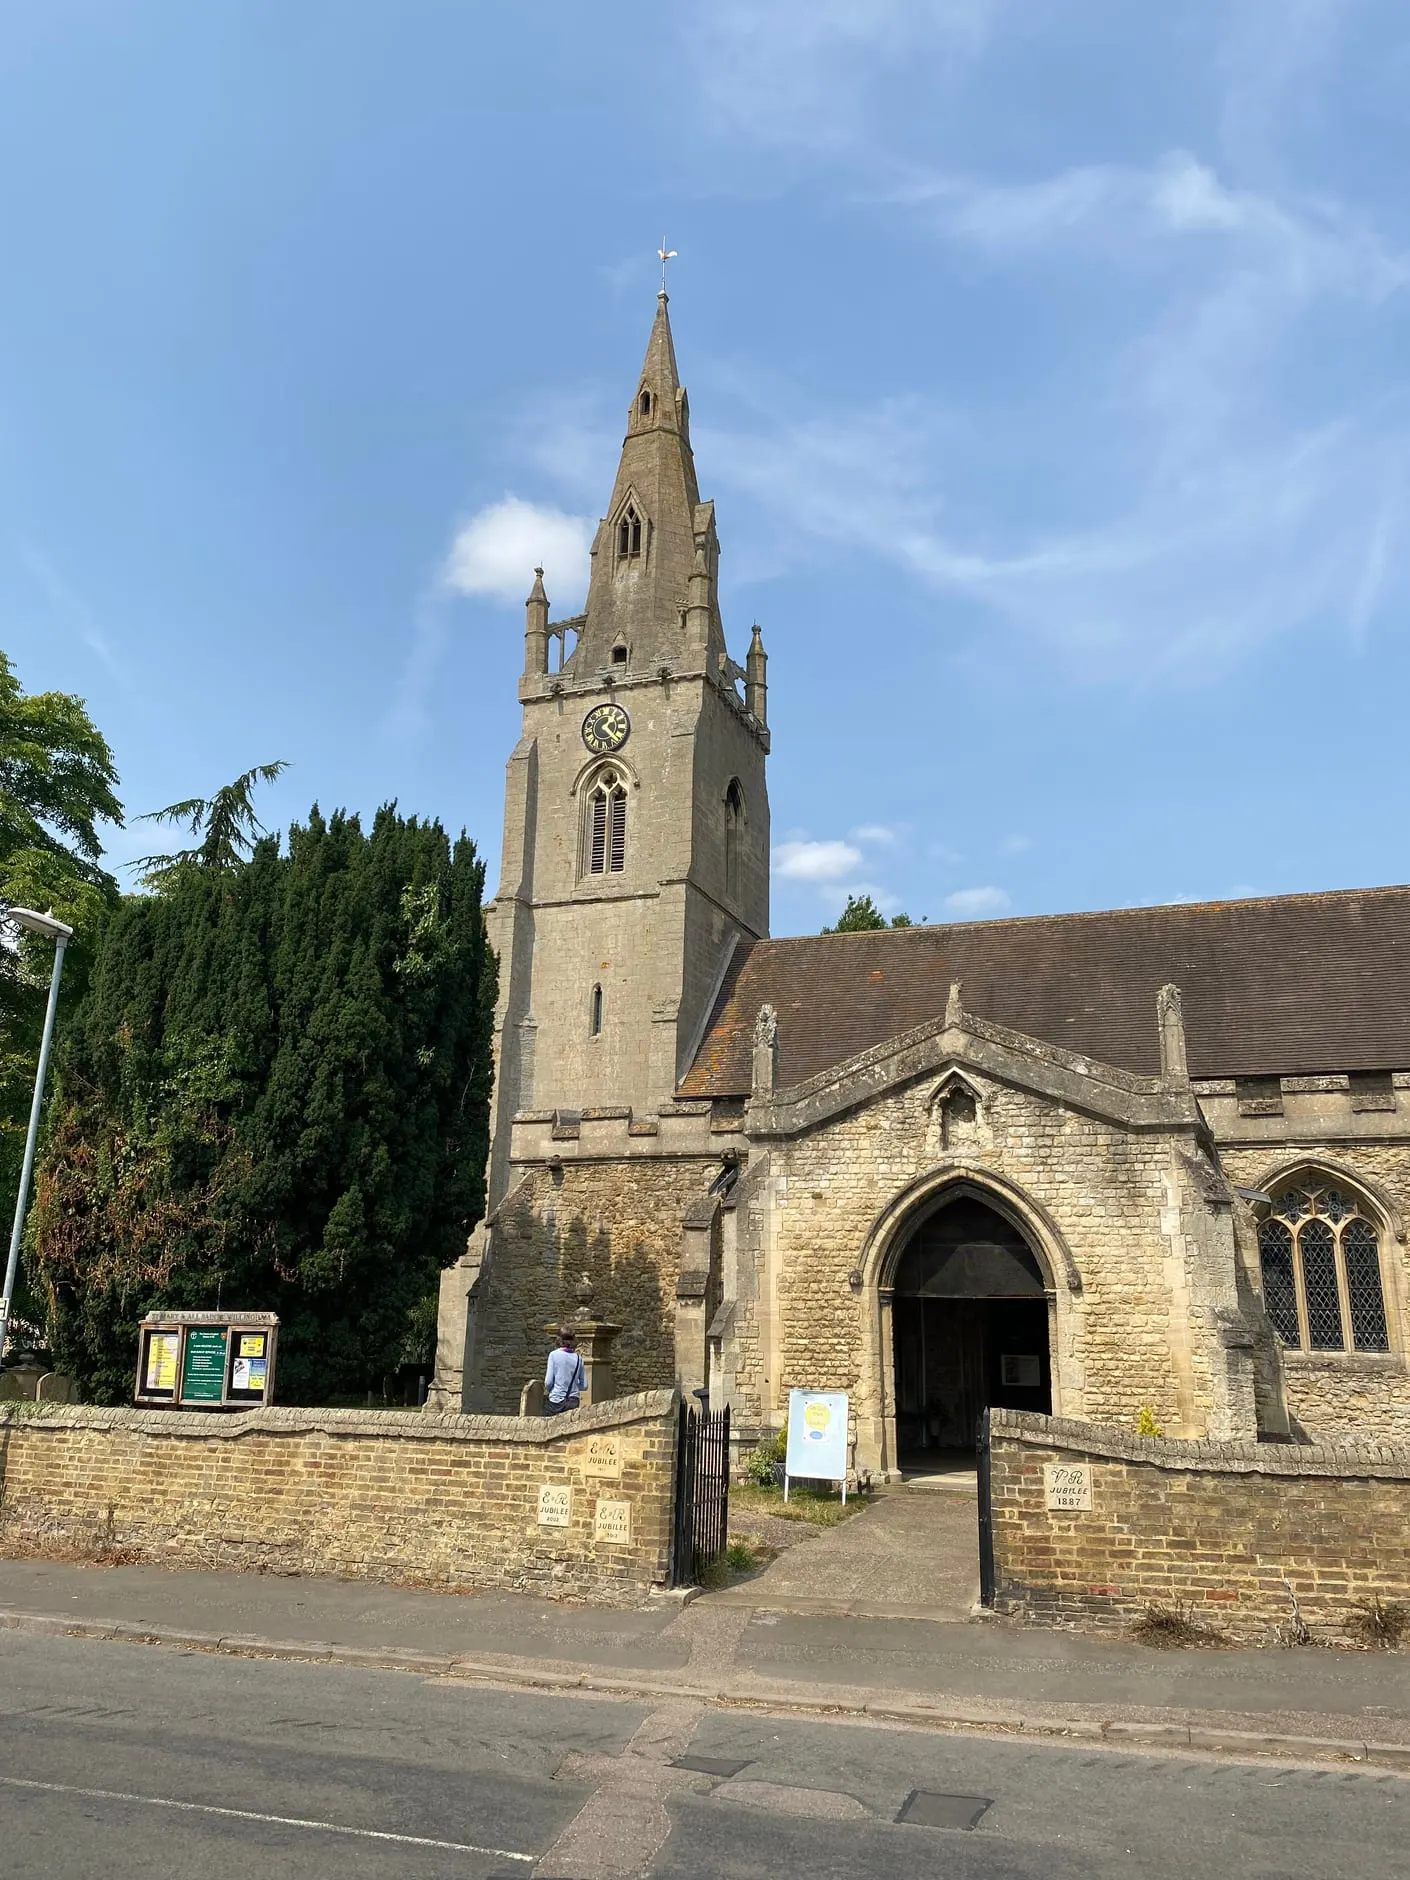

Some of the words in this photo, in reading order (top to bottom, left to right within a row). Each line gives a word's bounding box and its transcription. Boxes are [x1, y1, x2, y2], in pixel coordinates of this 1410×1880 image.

[160, 1312, 178, 1320] MARY
[588, 1457, 617, 1466] JUBILEE
[1058, 1497, 1080, 1506] 1887
[540, 1507, 568, 1516] JUBILEE
[598, 1522, 628, 1532] JUBILEE
